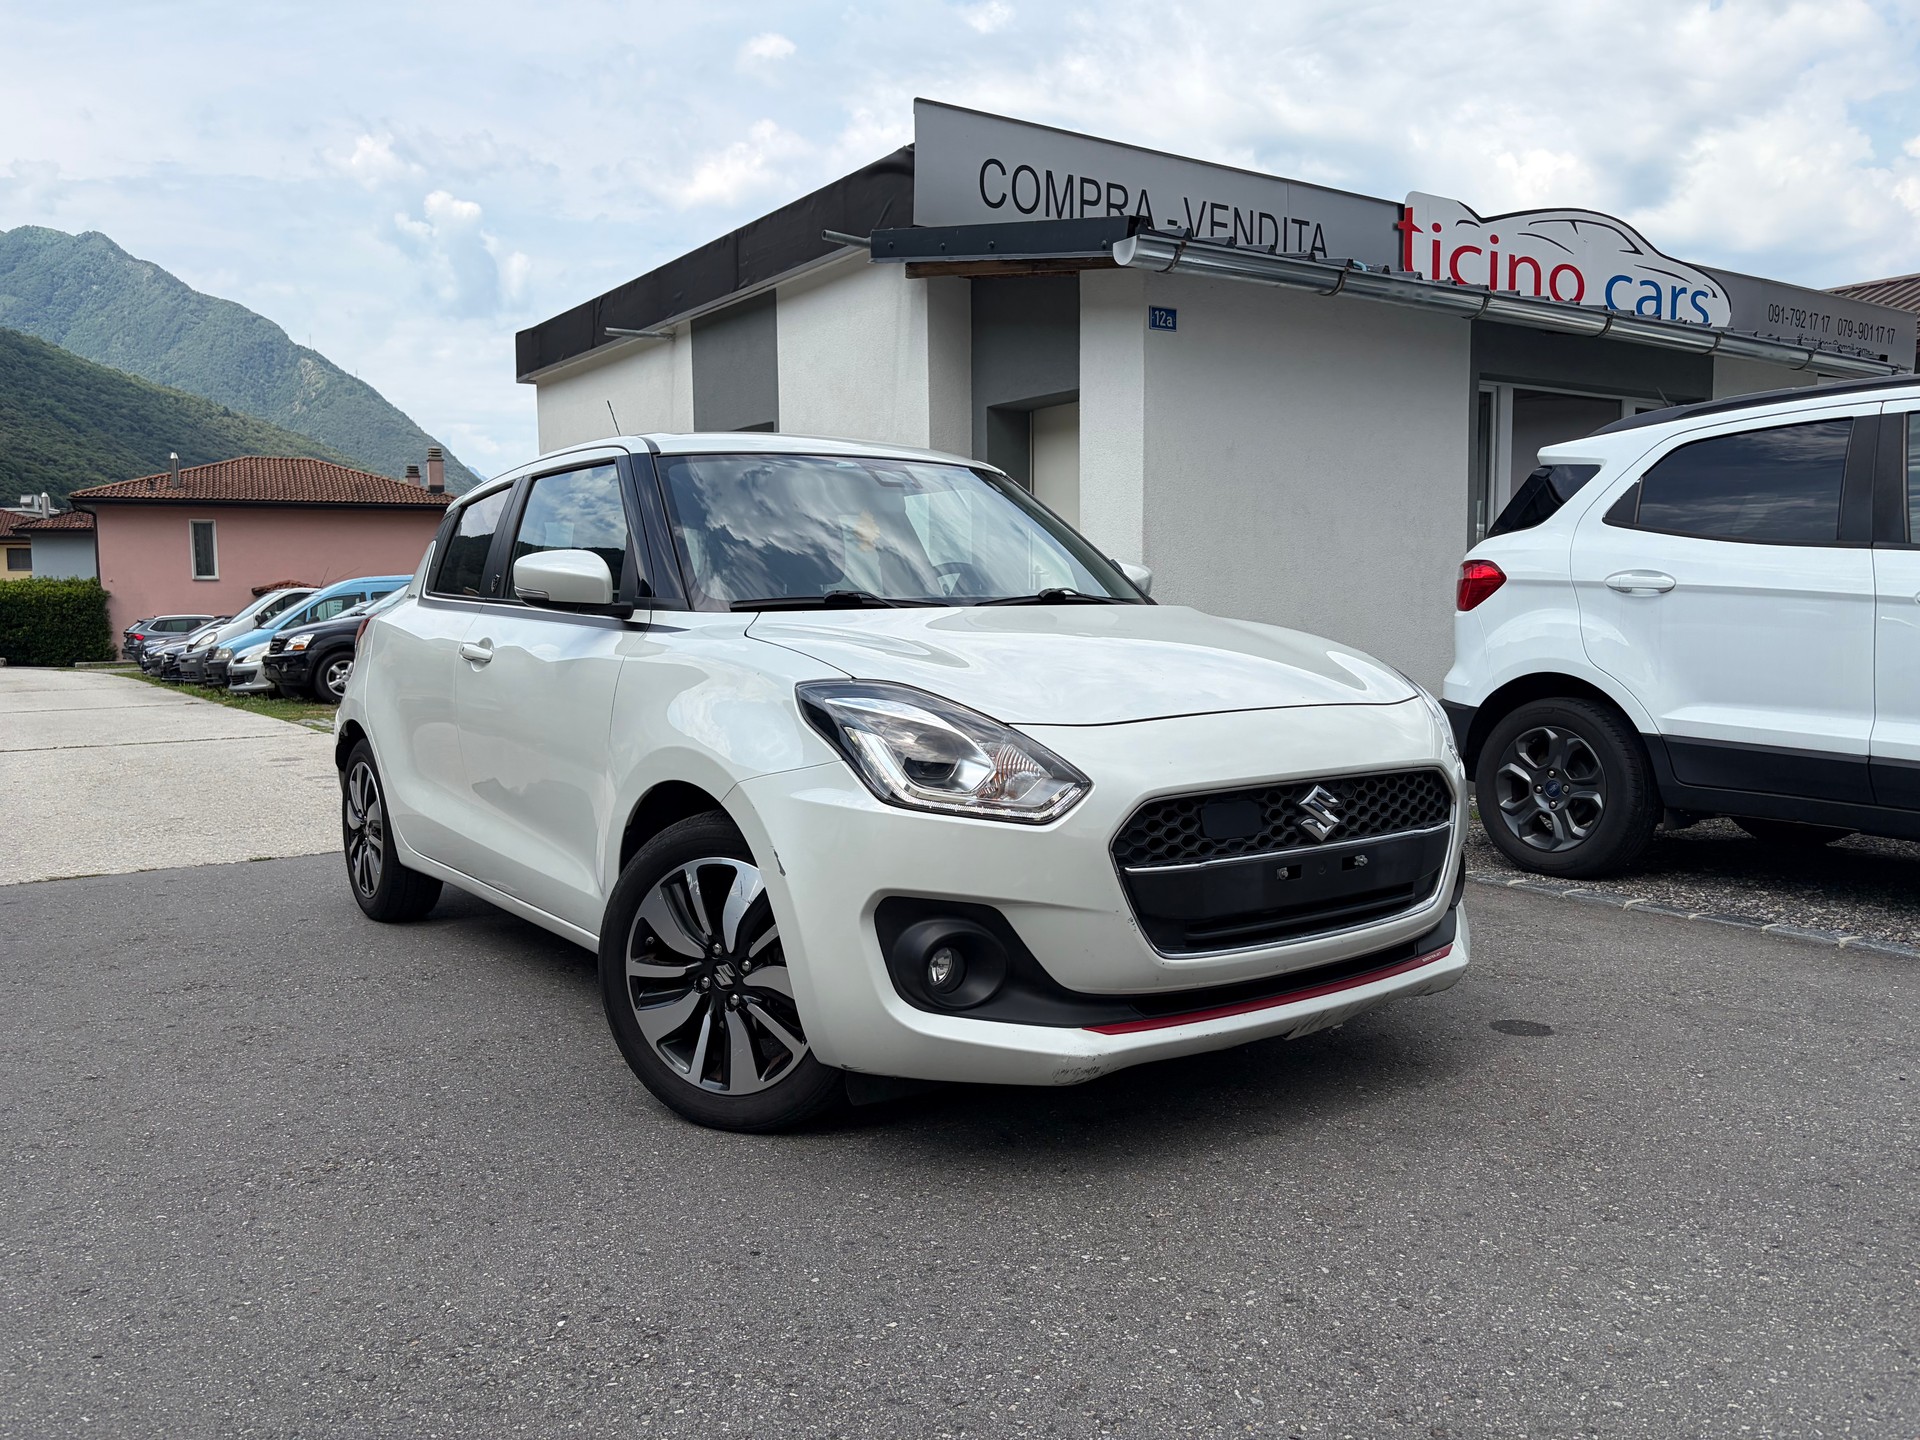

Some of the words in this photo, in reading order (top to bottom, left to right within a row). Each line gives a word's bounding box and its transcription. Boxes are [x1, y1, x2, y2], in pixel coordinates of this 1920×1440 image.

[980, 158, 1155, 229] COMPRA
[1398, 207, 1585, 302] ticino
[1604, 274, 1710, 323] cars
[1154, 310, 1173, 327] 12a
[1768, 303, 1806, 328] 091-792
